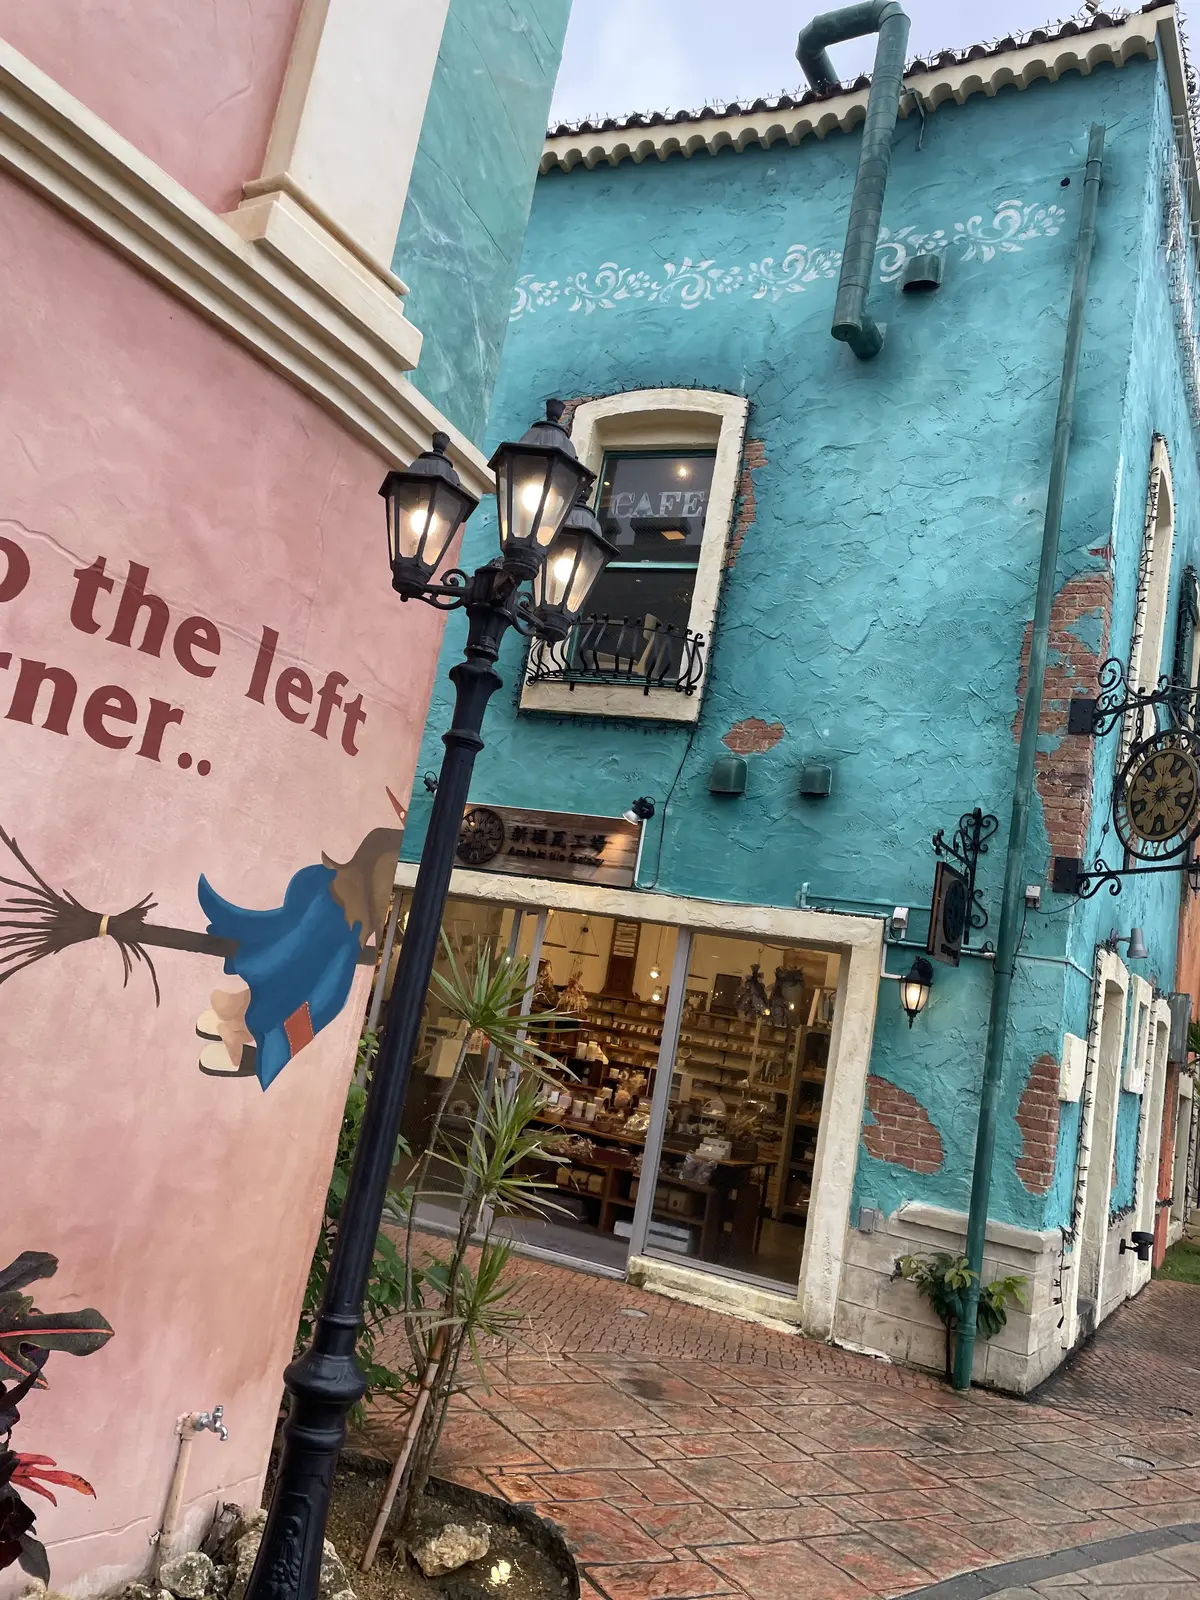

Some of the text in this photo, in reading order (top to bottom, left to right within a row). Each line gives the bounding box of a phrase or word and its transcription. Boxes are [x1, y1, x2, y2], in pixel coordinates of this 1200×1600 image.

[611, 491, 705, 518] CAFE
[0, 651, 212, 777] ner..
[70, 555, 222, 679] the
[244, 624, 367, 757] left
